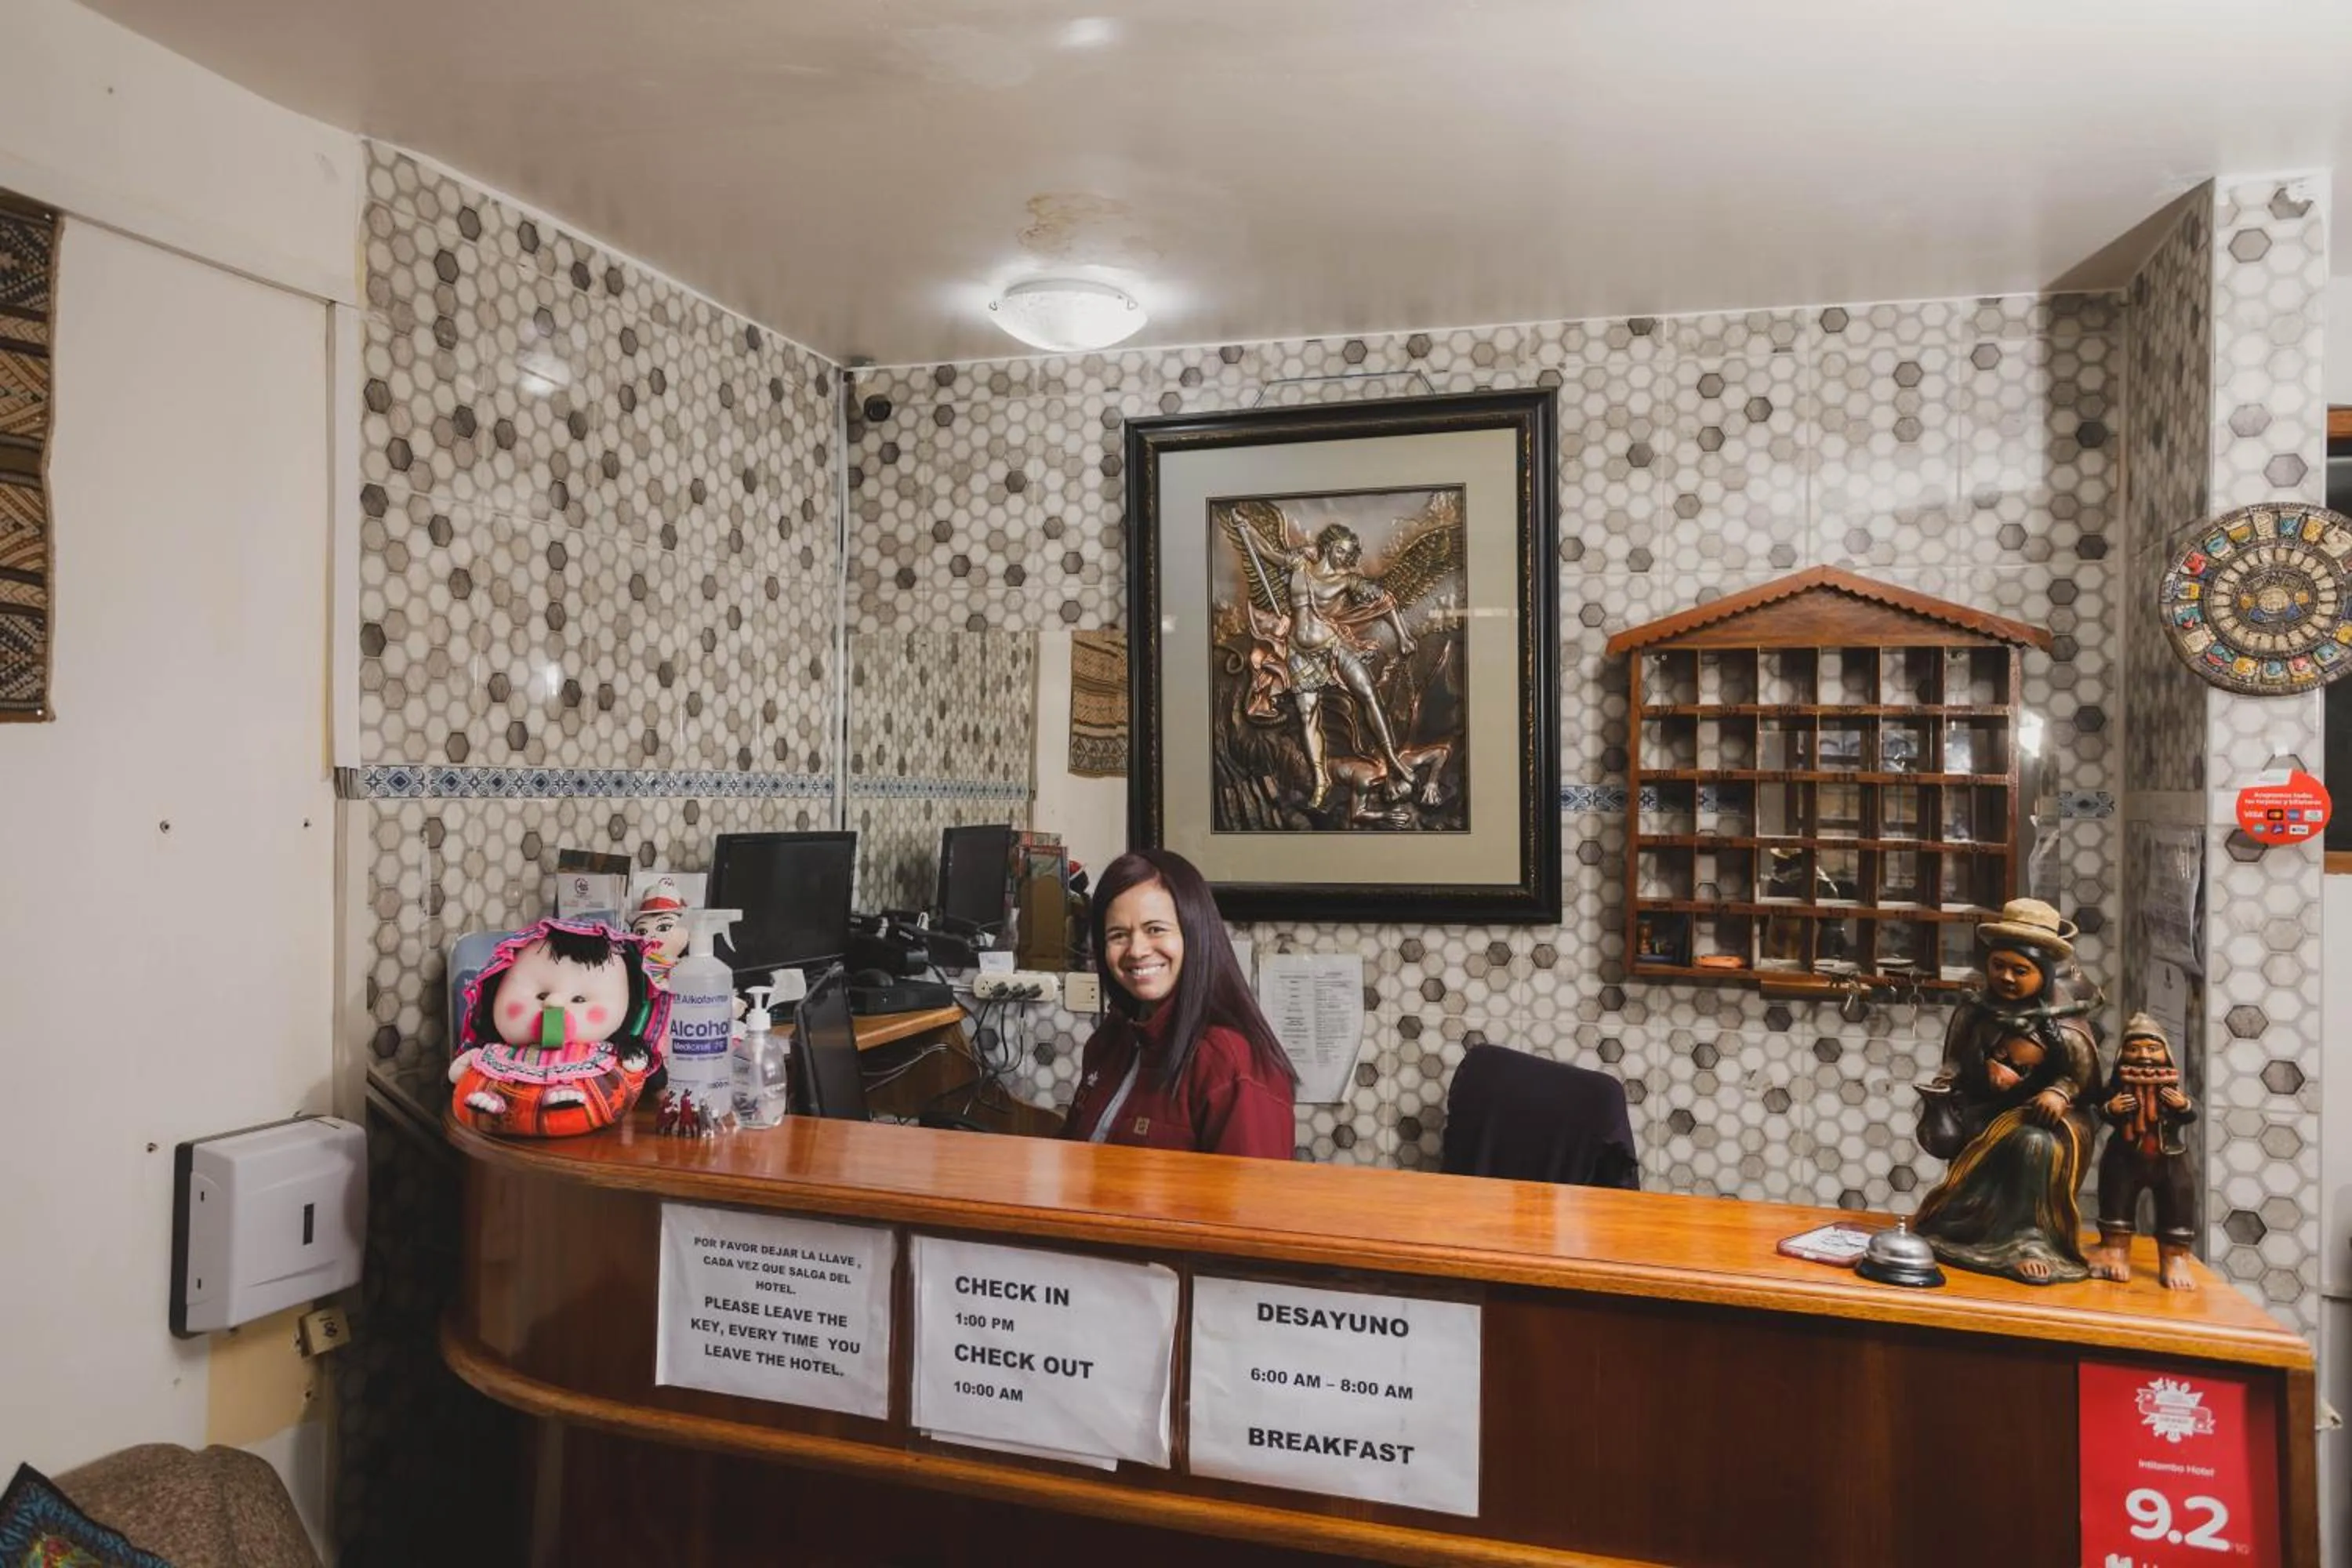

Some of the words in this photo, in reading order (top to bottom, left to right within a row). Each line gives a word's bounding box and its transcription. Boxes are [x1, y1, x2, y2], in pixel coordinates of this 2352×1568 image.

[694, 1236, 717, 1247] POR
[720, 1240, 758, 1254] FAVOR
[760, 1245, 798, 1258] DEJAR
[801, 1250, 816, 1261] LA
[818, 1252, 855, 1266] LLAVE
[702, 1255, 735, 1268] CADA
[736, 1259, 760, 1271] VEZ
[761, 1263, 786, 1276] QUE
[789, 1266, 826, 1280] SALGA
[829, 1272, 851, 1284] DEL
[755, 1280, 797, 1295] HOTEL.
[954, 1276, 1037, 1303] CHECK
[1044, 1286, 1070, 1308] IN
[704, 1295, 760, 1316] PLEASE
[764, 1304, 813, 1323] LEAVE
[816, 1311, 848, 1328] THE
[955, 1312, 987, 1328] 1:00
[991, 1316, 1014, 1333] PM
[1257, 1302, 1410, 1338] DESAYUNO
[691, 1317, 724, 1337] KEY,
[728, 1323, 778, 1342] EVERY
[782, 1330, 819, 1348] TIME
[827, 1338, 861, 1355] YOU
[704, 1343, 752, 1363] LEAVE
[755, 1351, 786, 1367] THE
[789, 1356, 844, 1377] HOTEL.
[954, 1343, 1036, 1372] CHECK
[1043, 1356, 1094, 1380] OUT
[953, 1380, 995, 1398] 10:00
[998, 1387, 1023, 1403] AM
[1250, 1367, 1288, 1385] 6:00
[1293, 1373, 1321, 1389] AM
[1340, 1378, 1380, 1396] 8:00
[1384, 1384, 1414, 1401] AM
[1247, 1426, 1415, 1465] BREAKFAST
[2125, 1488, 2230, 1552] 9.2
